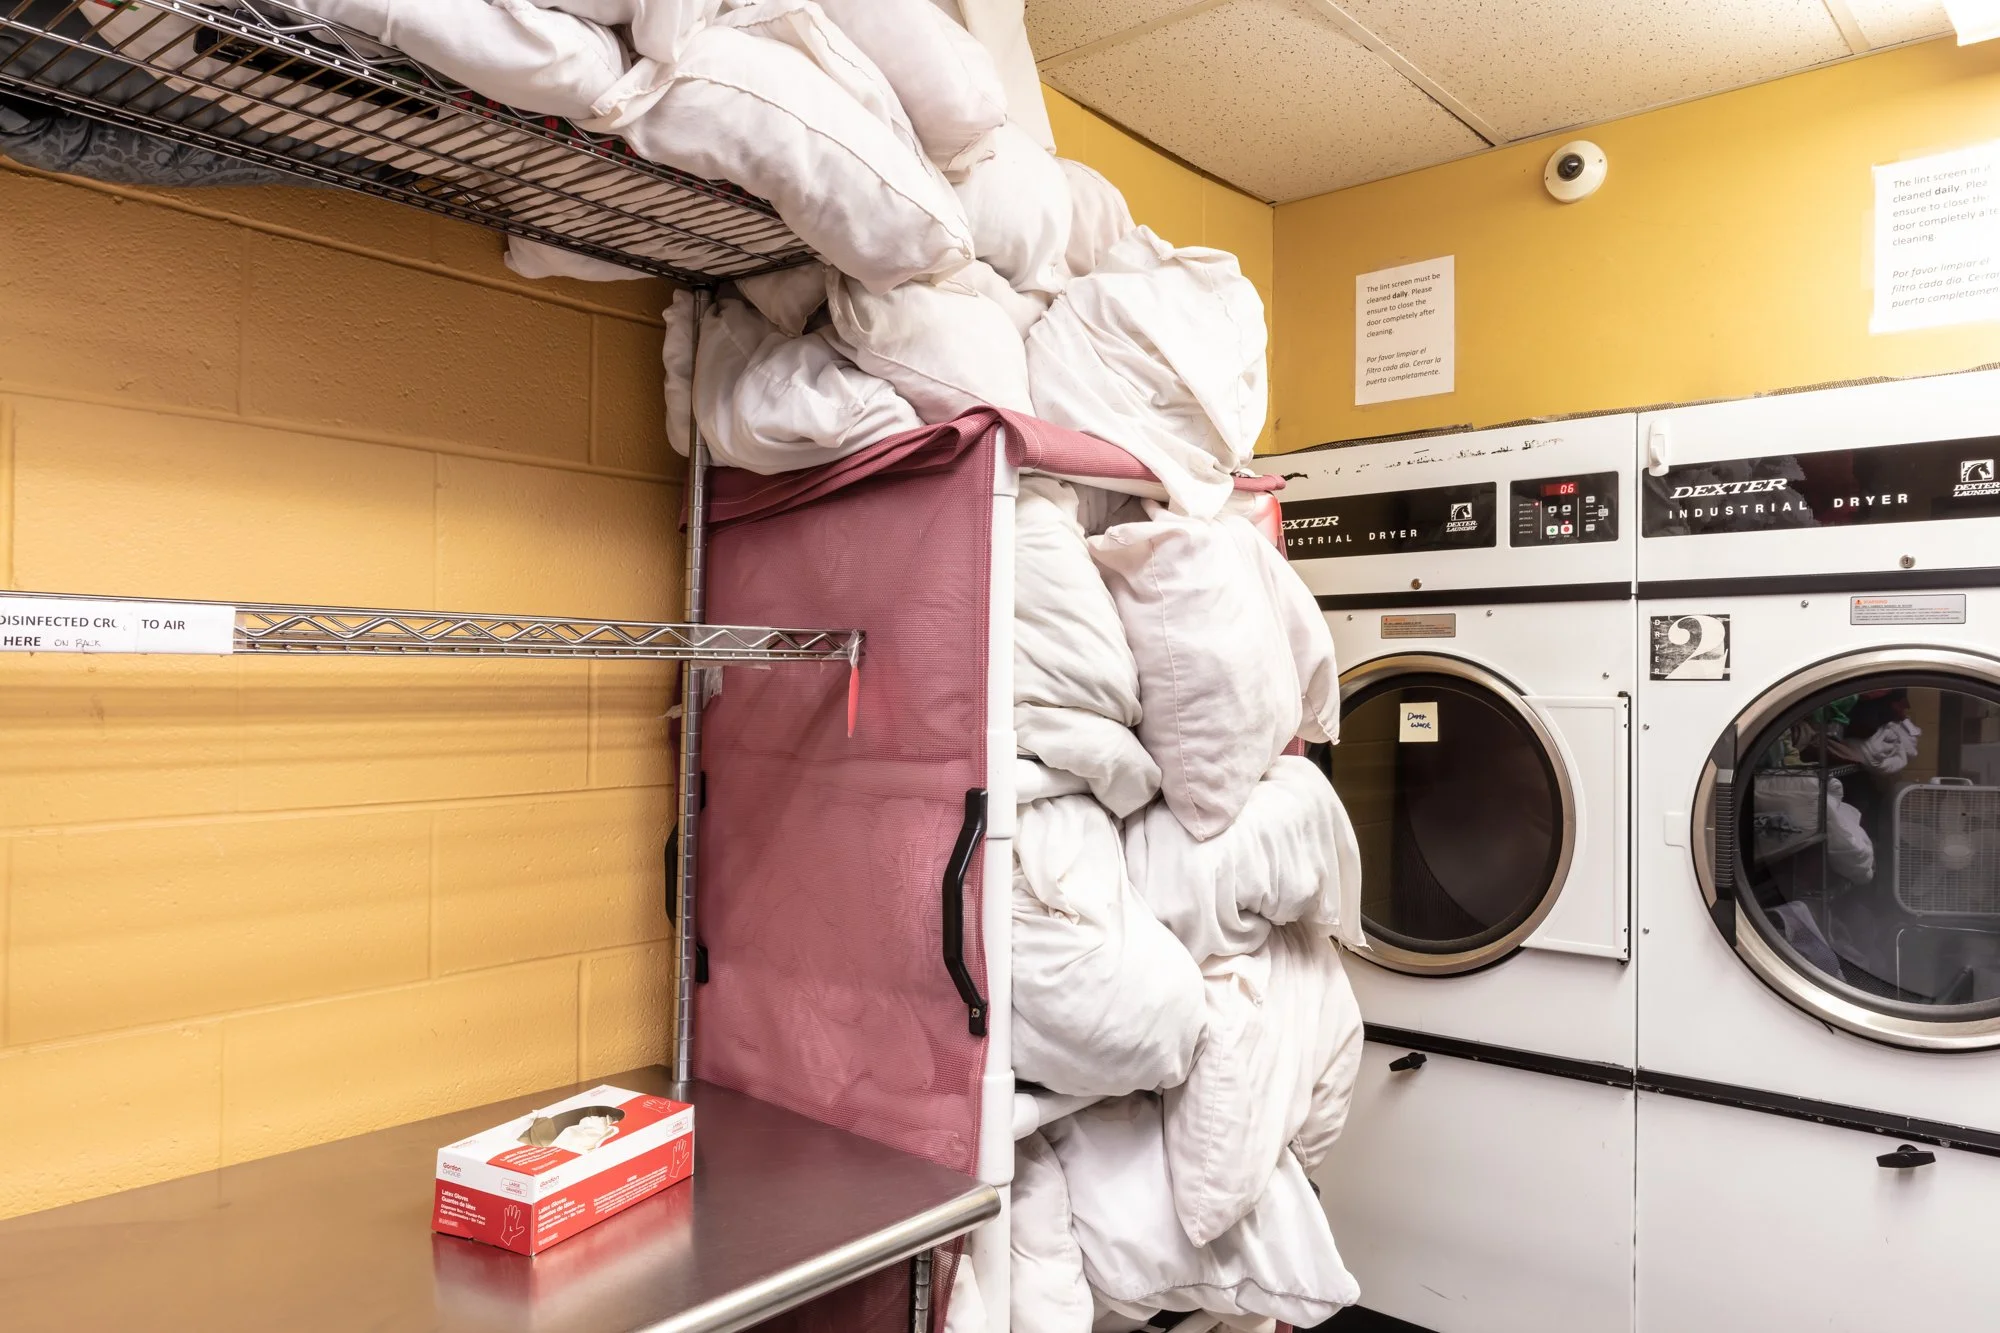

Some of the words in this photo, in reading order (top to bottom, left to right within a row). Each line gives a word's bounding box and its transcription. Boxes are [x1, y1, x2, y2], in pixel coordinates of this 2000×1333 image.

[1893, 180, 1911, 188] The
[1914, 176, 1930, 184] lint
[1933, 169, 1967, 180] screen
[1892, 189, 1932, 203] cleaned
[1934, 184, 1962, 195] daily.
[1892, 205, 1927, 217] ensure
[1930, 202, 1940, 211] to
[1943, 197, 1969, 208] close
[1892, 220, 1915, 232] door
[1919, 210, 1976, 228] completely
[1892, 232, 1937, 246] cleaning.
[1892, 270, 1909, 278] Por
[1910, 265, 1937, 278] favor
[1940, 260, 1977, 273] limpiar
[1391, 279, 1413, 288] screen
[1414, 275, 1430, 284] must
[1891, 283, 1916, 295] filtro
[1918, 280, 1943, 289] cada
[1366, 294, 1391, 304] cleaned
[1392, 290, 1409, 300] daily.
[1411, 286, 1433, 295] Please
[1891, 296, 1925, 308] puerta
[1927, 286, 2000, 303] completamen
[1366, 306, 1388, 315] ensure
[1398, 301, 1414, 309] close
[1382, 311, 1418, 324] completely
[1419, 308, 1436, 317] after
[1366, 327, 1395, 338] cleaning.
[1377, 352, 1395, 362] favor
[1396, 348, 1419, 359] limpiar
[1365, 367, 1382, 375] filtro
[1382, 363, 1398, 371] cada
[1413, 357, 1433, 366] Cerrar
[1365, 376, 1387, 386] puerta
[1388, 369, 1441, 383] completamente.
[1560, 483, 1575, 494] 06
[1669, 478, 1788, 500] DEXTER
[1953, 481, 2000, 491] DEXTER
[1668, 500, 1807, 519] INDUSTRIAL
[1833, 493, 1909, 508] DRYER
[1282, 516, 1340, 530] EXTER
[1446, 520, 1477, 528] DEXTER
[1287, 534, 1352, 547] USTRIAL
[1369, 529, 1418, 541] DRYER
[0, 615, 89, 628] DISINFECTED
[141, 619, 159, 630] TO
[164, 620, 186, 630] AIR
[3, 636, 42, 647] HERE
[54, 638, 69, 647] ON
[1664, 615, 1729, 679] 2
[442, 1162, 462, 1172] Gordon
[442, 1169, 461, 1179] CHOICE
[441, 1189, 454, 1198] Latex
[453, 1192, 469, 1203] Gloves
[441, 1195, 459, 1206] Guantes
